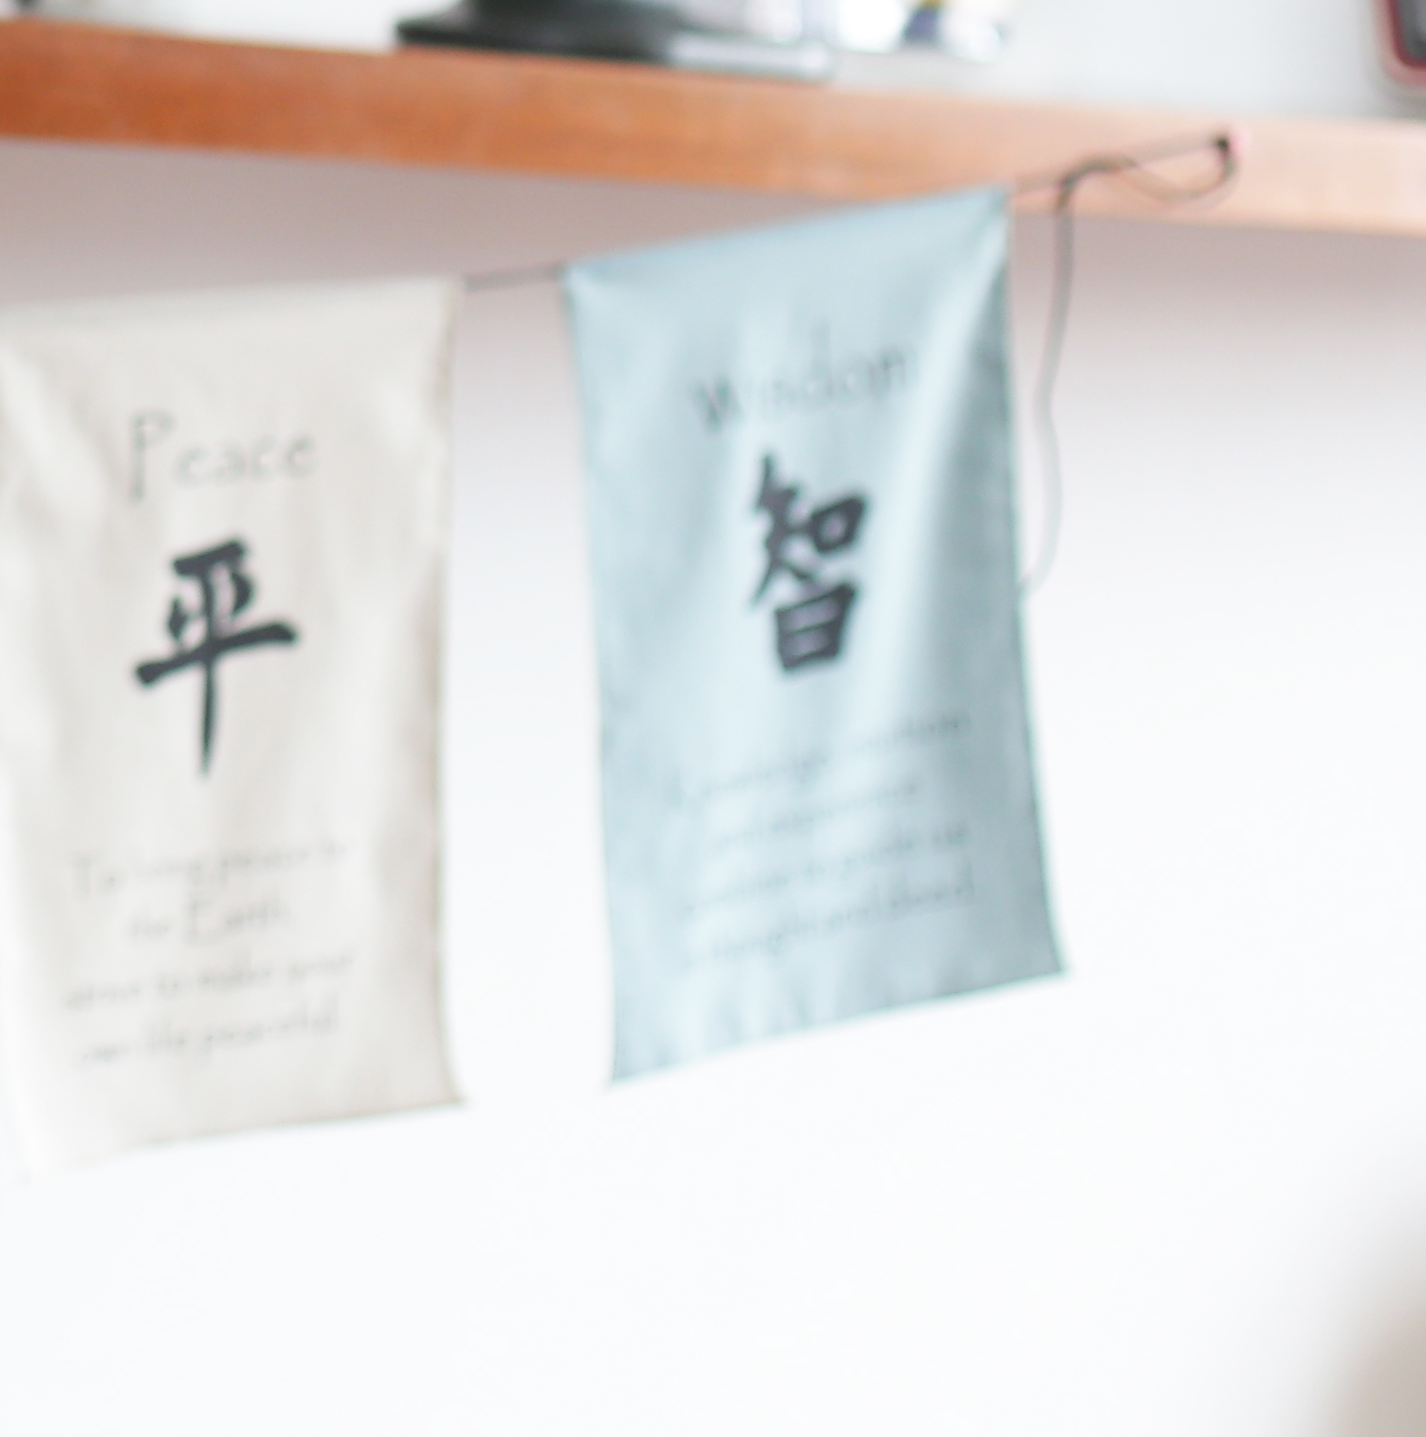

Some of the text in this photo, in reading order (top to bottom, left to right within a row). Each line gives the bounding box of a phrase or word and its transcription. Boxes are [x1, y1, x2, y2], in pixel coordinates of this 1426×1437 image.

[129, 411, 317, 505] Peace
[749, 451, 872, 673] 智
[134, 535, 298, 779] 平
